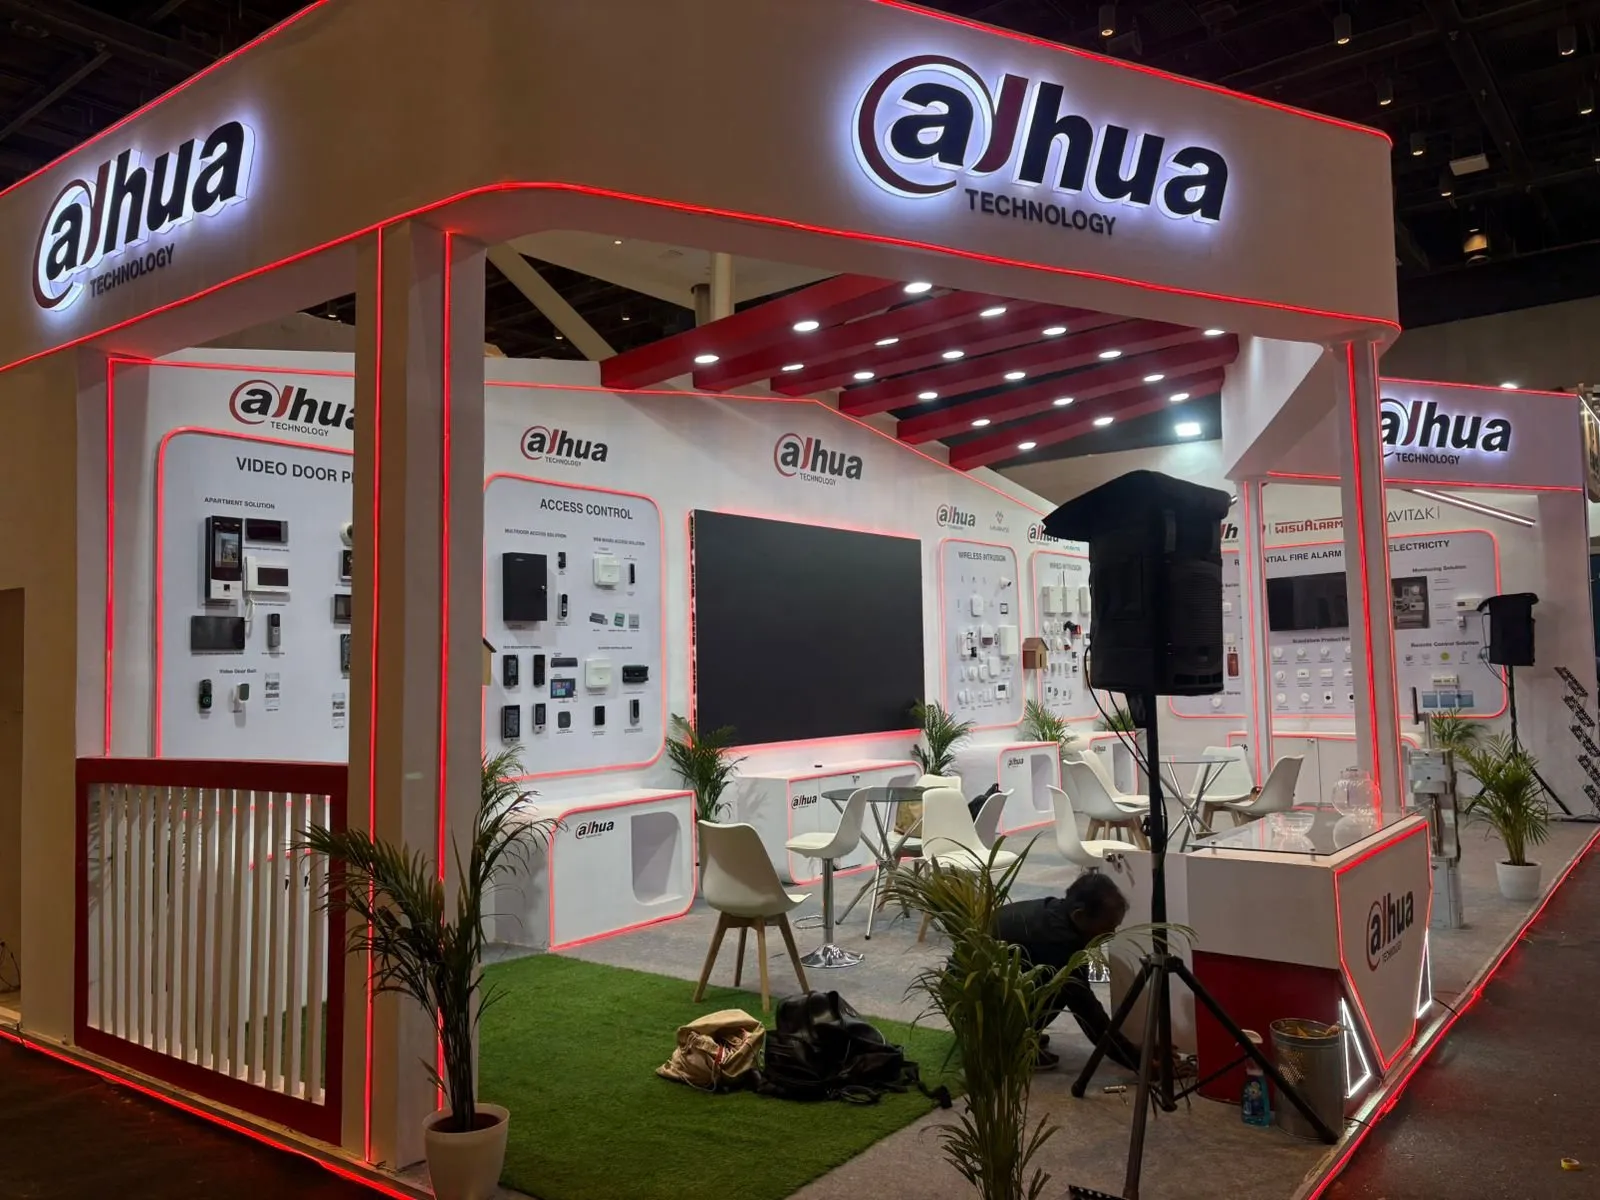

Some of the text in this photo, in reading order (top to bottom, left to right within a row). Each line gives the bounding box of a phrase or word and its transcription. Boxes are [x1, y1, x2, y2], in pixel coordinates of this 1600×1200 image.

[964, 187, 1117, 237] TECHNOLOGY
[90, 243, 175, 298] TECHNOLOGY
[270, 421, 330, 437] TECHNOLOGY
[1395, 452, 1460, 465] TECHNOLOGY
[236, 456, 288, 476] VIDEO
[292, 464, 337, 482] DOOR
[799, 472, 837, 487] TECHNOLOGY
[540, 498, 633, 520] ACCESS CONTROL
[1388, 540, 1450, 553] ELECTRICITY
[1289, 552, 1309, 561] FIRE
[1311, 550, 1342, 560] ALARM
